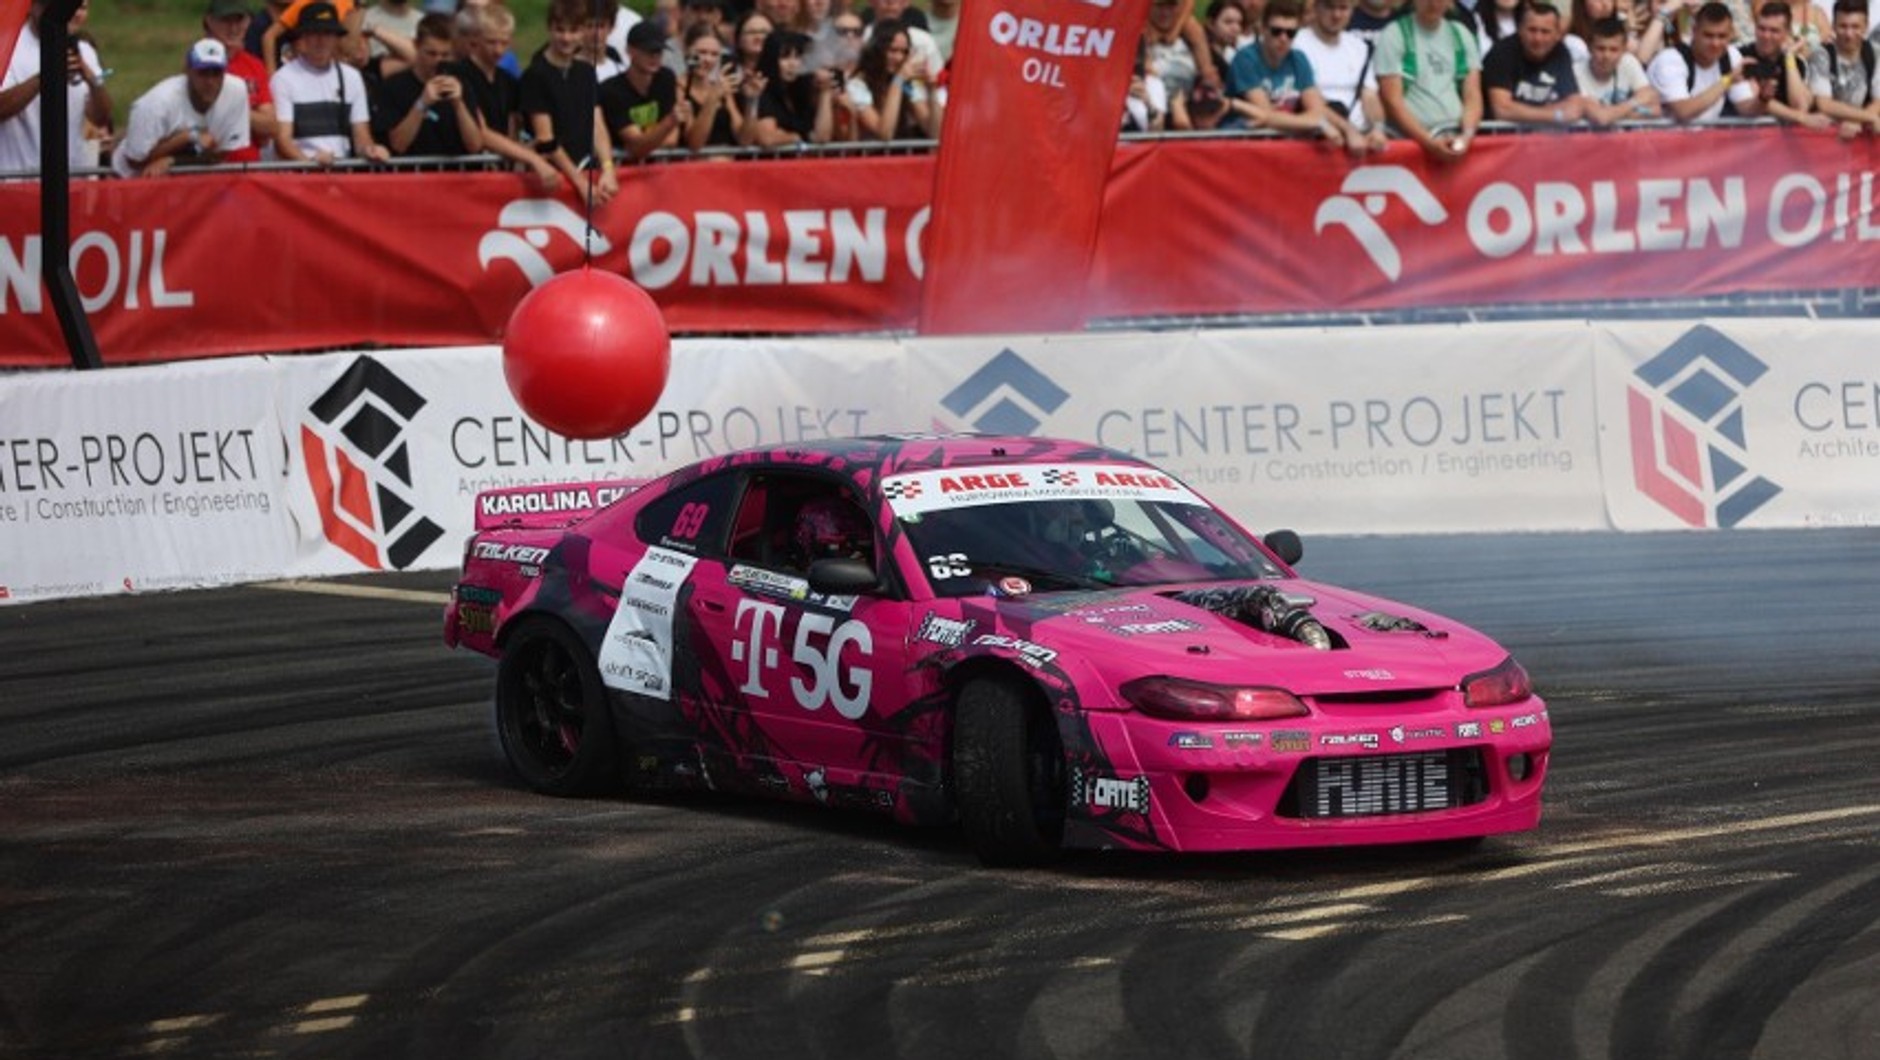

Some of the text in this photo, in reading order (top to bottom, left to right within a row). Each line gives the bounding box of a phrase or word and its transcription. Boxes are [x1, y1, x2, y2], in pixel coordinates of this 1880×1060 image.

[989, 11, 1115, 58] ORLEN
[1022, 57, 1066, 88] OIL
[1466, 172, 1880, 258] ORLEN OIL
[627, 208, 888, 289] ORLEN
[68, 229, 193, 314] OIL
[1096, 390, 1565, 459] CENTER-PROJEKT
[940, 470, 1180, 493] ARGE ARGE
[1265, 456, 1413, 482] Construction
[1436, 448, 1573, 477] Engineering
[37, 491, 145, 520] Construction
[163, 489, 271, 517] Engineering
[482, 491, 593, 515] KAROLINA
[671, 502, 709, 539] 69
[473, 542, 550, 564] FALKEN
[791, 612, 873, 720] 5G
[1085, 777, 1140, 811] FORTE
